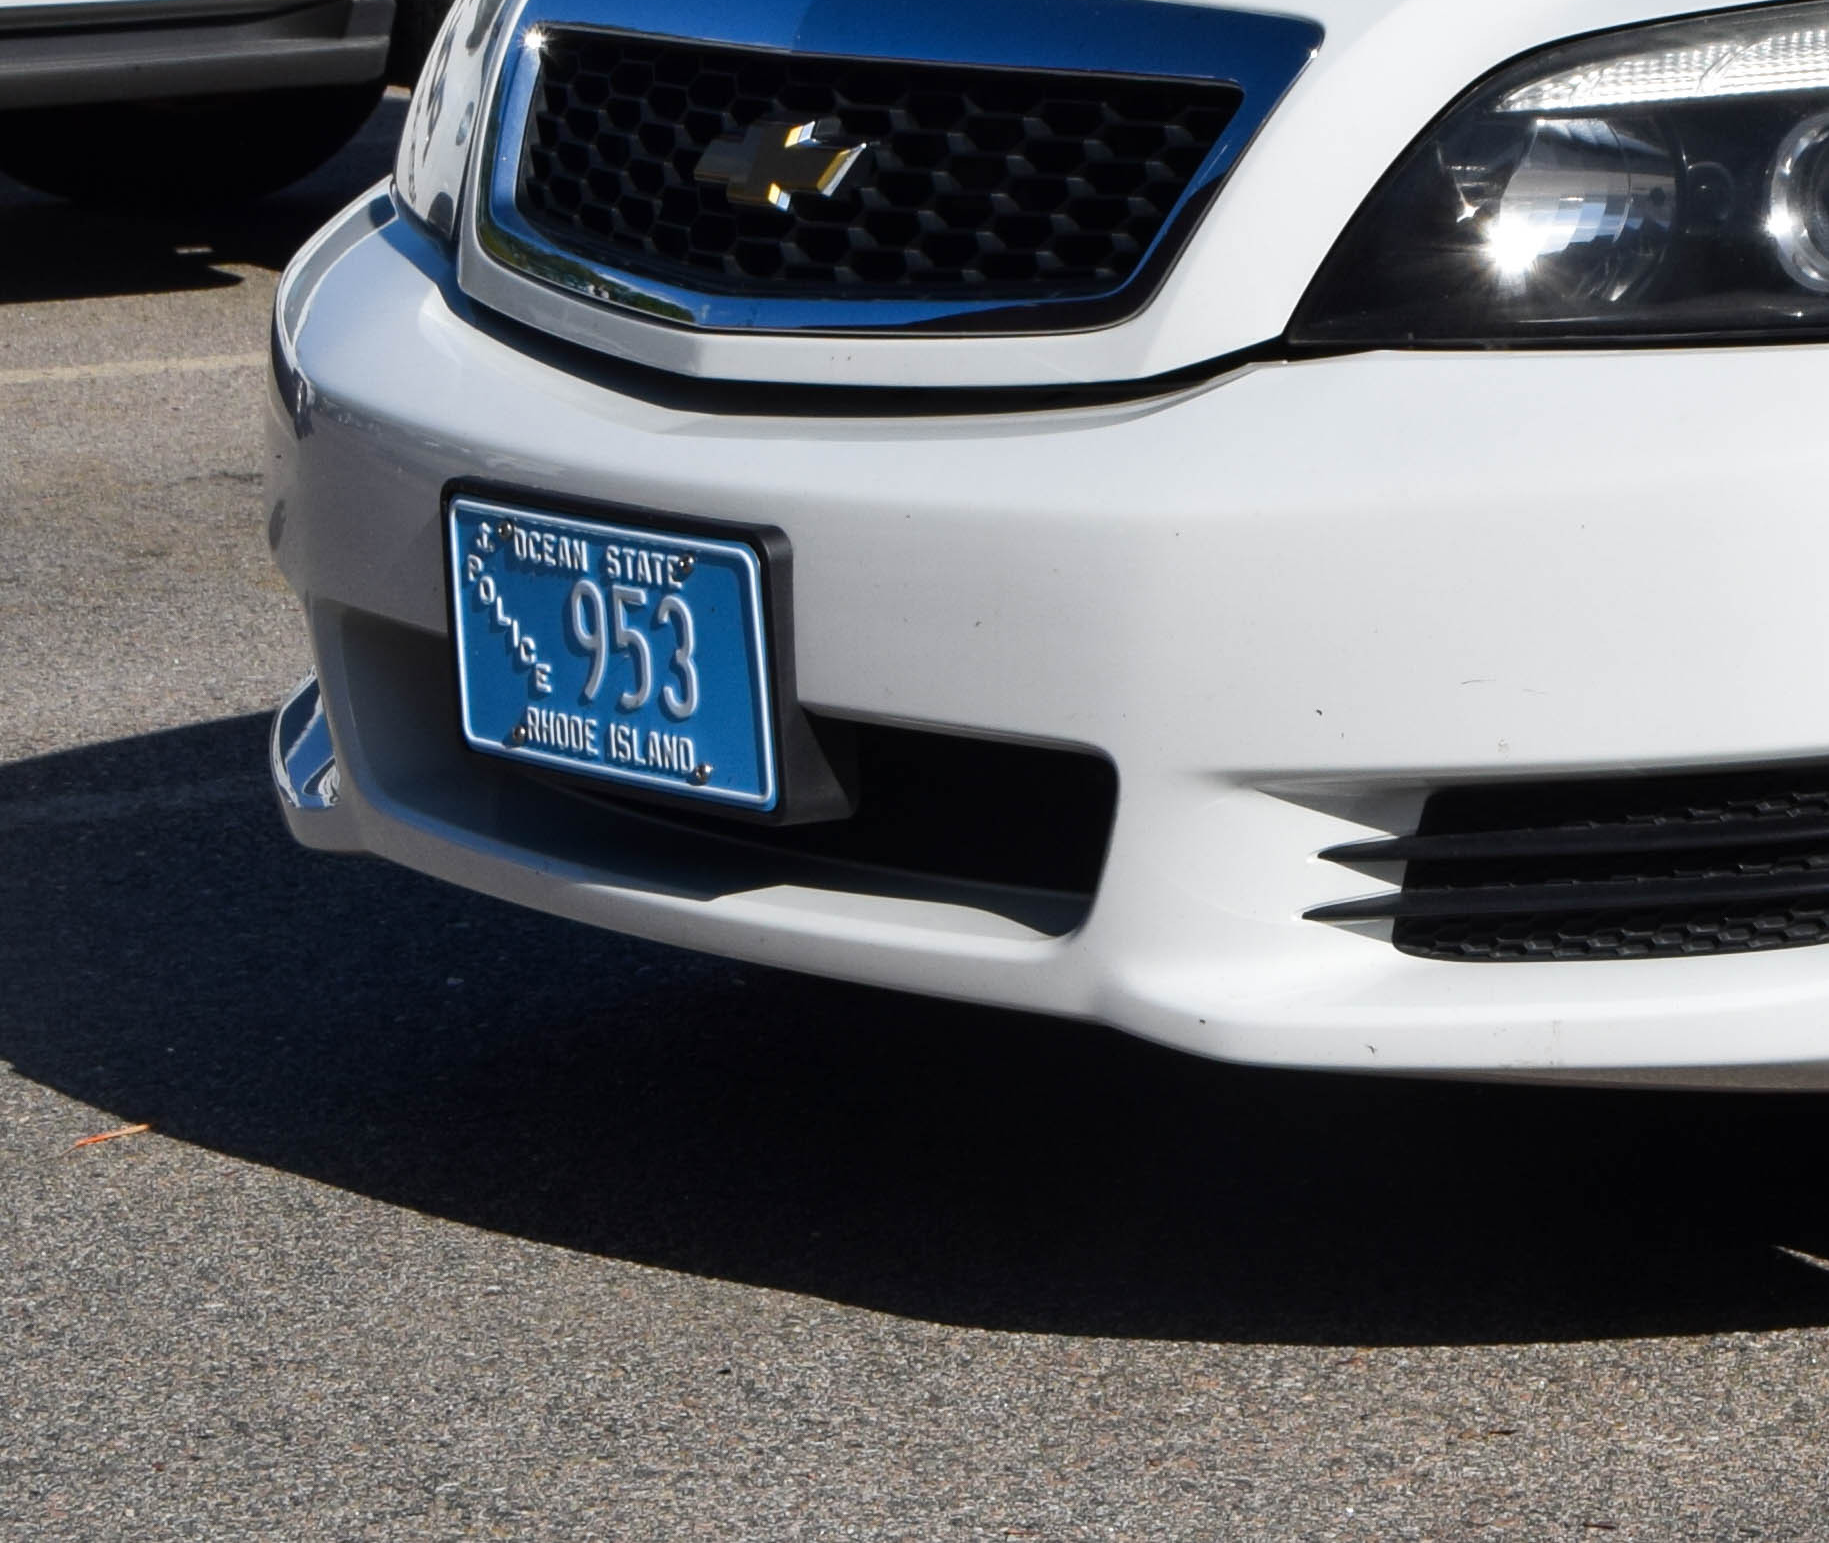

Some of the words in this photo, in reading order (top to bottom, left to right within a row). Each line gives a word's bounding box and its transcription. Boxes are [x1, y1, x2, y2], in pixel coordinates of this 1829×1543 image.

[513, 526, 590, 573] OCEAN
[606, 544, 684, 590] STATE
[467, 553, 553, 694] POLICE
[570, 578, 700, 719] 953
[526, 705, 600, 756] RHODE
[609, 722, 696, 774] ISLAND
